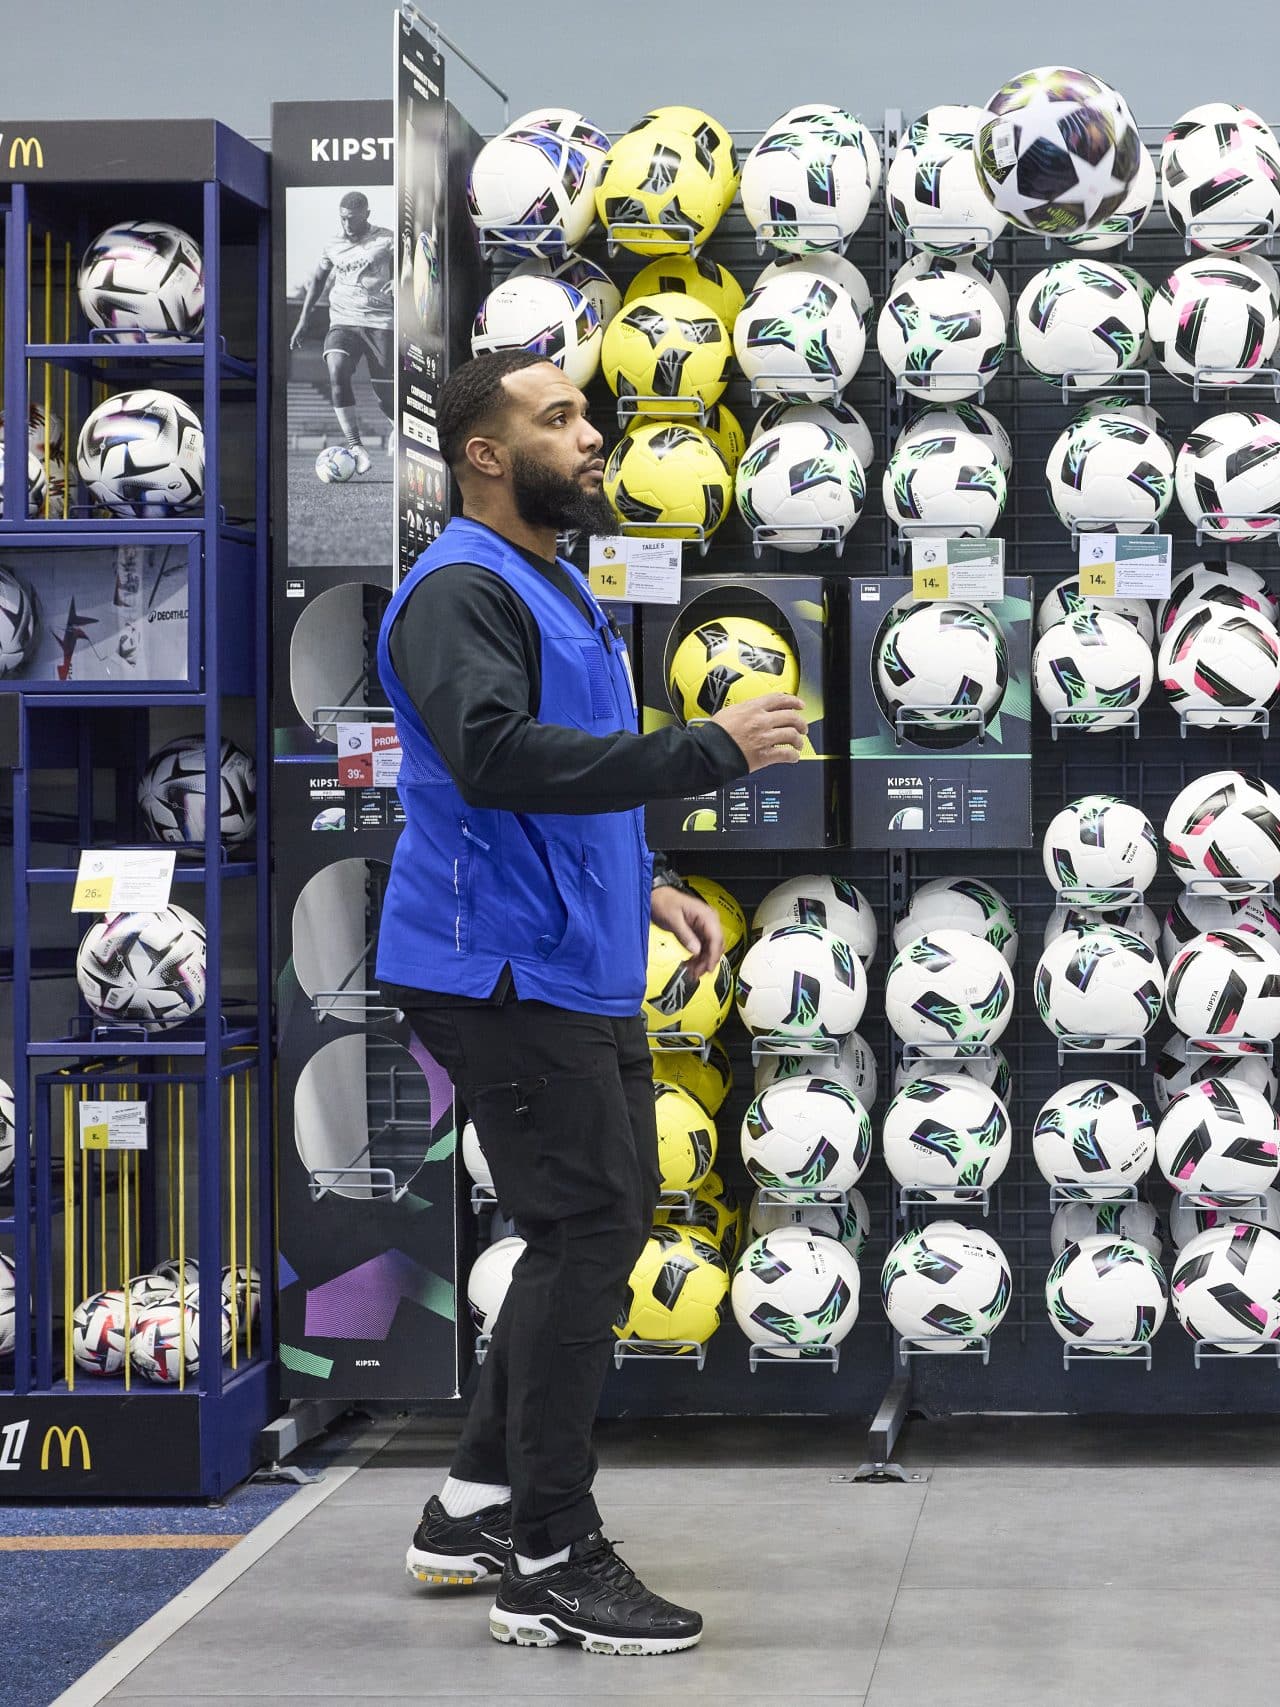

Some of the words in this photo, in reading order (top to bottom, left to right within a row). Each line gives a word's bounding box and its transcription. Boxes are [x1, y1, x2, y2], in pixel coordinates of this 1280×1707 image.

[311, 138, 395, 162] KIPST
[913, 492, 925, 515] KIPSTA
[642, 543, 660, 551] TAILLE
[375, 736, 399, 747] PROM
[310, 779, 342, 788] KIPST
[887, 777, 923, 786] KIPSTA
[1246, 905, 1265, 918] KIPSTA
[1205, 989, 1220, 1012] KIPSTA
[355, 1360, 381, 1368] KIPSTA
